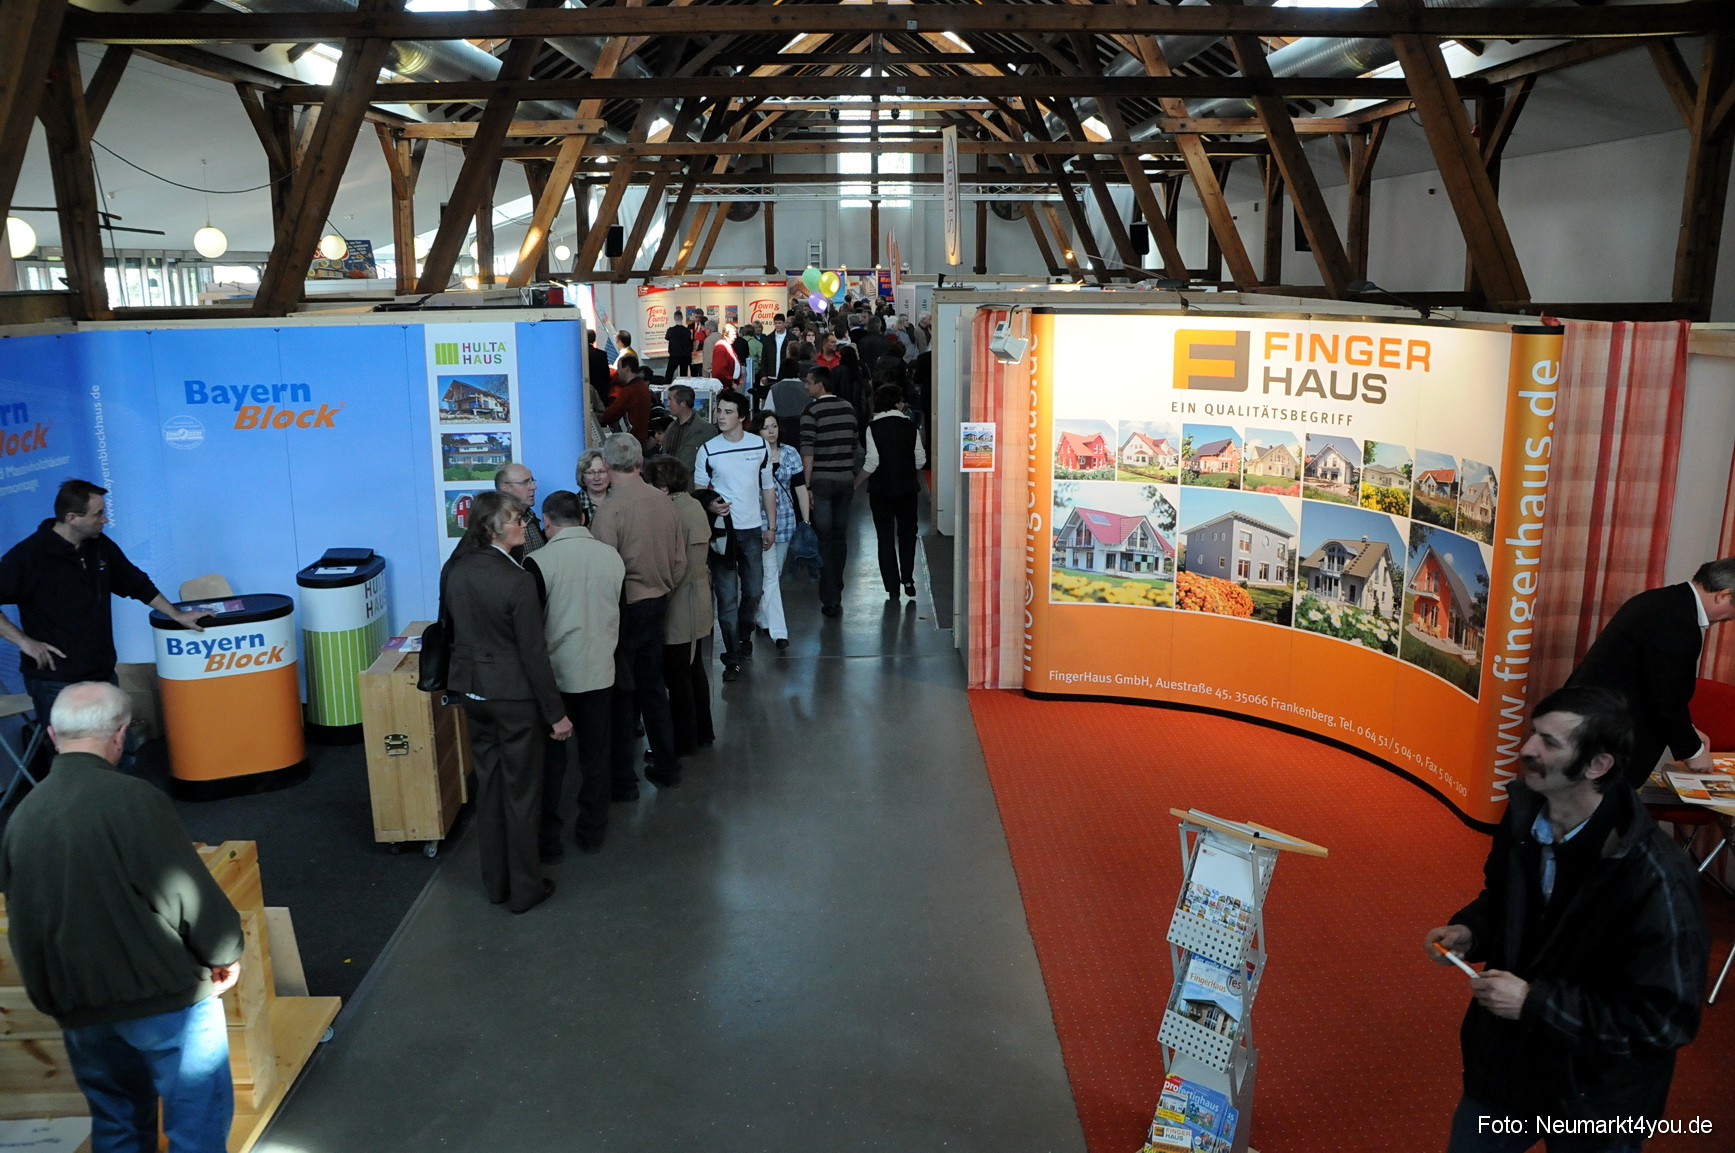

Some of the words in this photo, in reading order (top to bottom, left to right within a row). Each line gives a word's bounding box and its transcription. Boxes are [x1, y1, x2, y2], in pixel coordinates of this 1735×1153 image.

[749, 299, 778, 311] Town
[774, 303, 780, 311] &
[750, 310, 775, 323] Count
[462, 342, 506, 352] HULTA
[463, 354, 502, 364] HAUS
[1264, 331, 1431, 372] FINGER
[184, 380, 311, 411] Bayern
[1262, 366, 1388, 405] HAUS
[1171, 402, 1196, 414] EIN
[1204, 404, 1353, 426] QUALITÄTSBEGRIFF
[1491, 359, 1560, 803] www.fingerhaus.de
[166, 633, 265, 659] Bayern
[1049, 670, 1112, 684] FingerHaus
[1115, 674, 1153, 689] GmbH,
[1155, 678, 1213, 696] Auestraße
[1215, 688, 1232, 700] 45,
[1235, 692, 1268, 707] 35066
[1271, 697, 1337, 728] Frankenberg,
[1339, 716, 1355, 733] Tel.
[1425, 757, 1438, 775] Fax
[1189, 972, 1227, 993] FingerHaus
[1164, 1080, 1219, 1113] profertighaus
[1165, 1127, 1191, 1137] FINGER
[1165, 1133, 1184, 1141] HAUS
